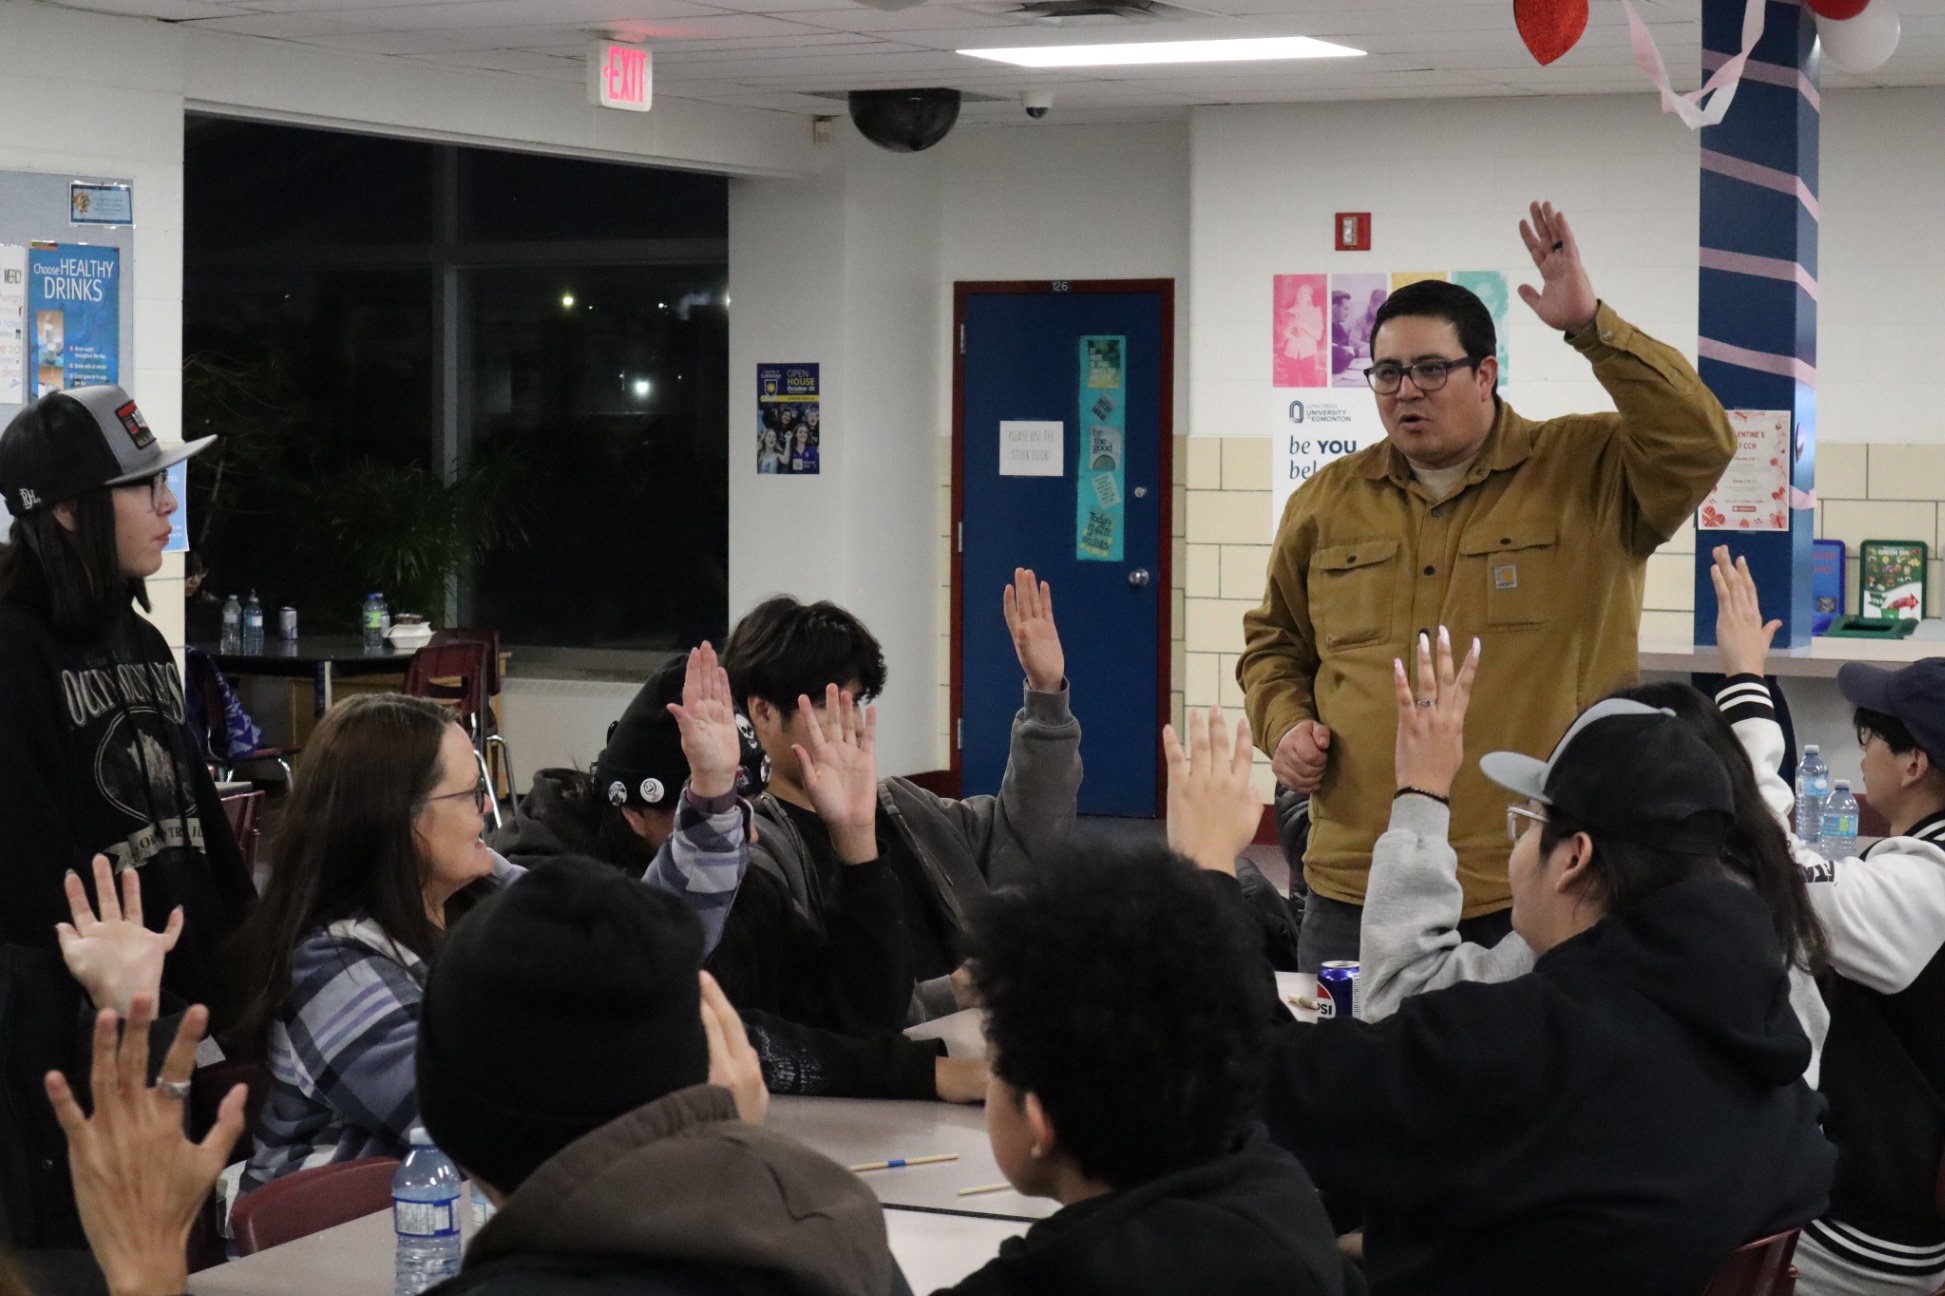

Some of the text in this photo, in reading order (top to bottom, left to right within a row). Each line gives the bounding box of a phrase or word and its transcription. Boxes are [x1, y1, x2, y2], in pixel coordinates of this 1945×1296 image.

[608, 45, 647, 104] EXIT
[4, 268, 22, 285] MERCY
[34, 258, 114, 279] Choose HEALTHY
[44, 277, 103, 302] DRINKS
[787, 369, 808, 377] OPEN
[1289, 435, 1357, 455] be YOU
